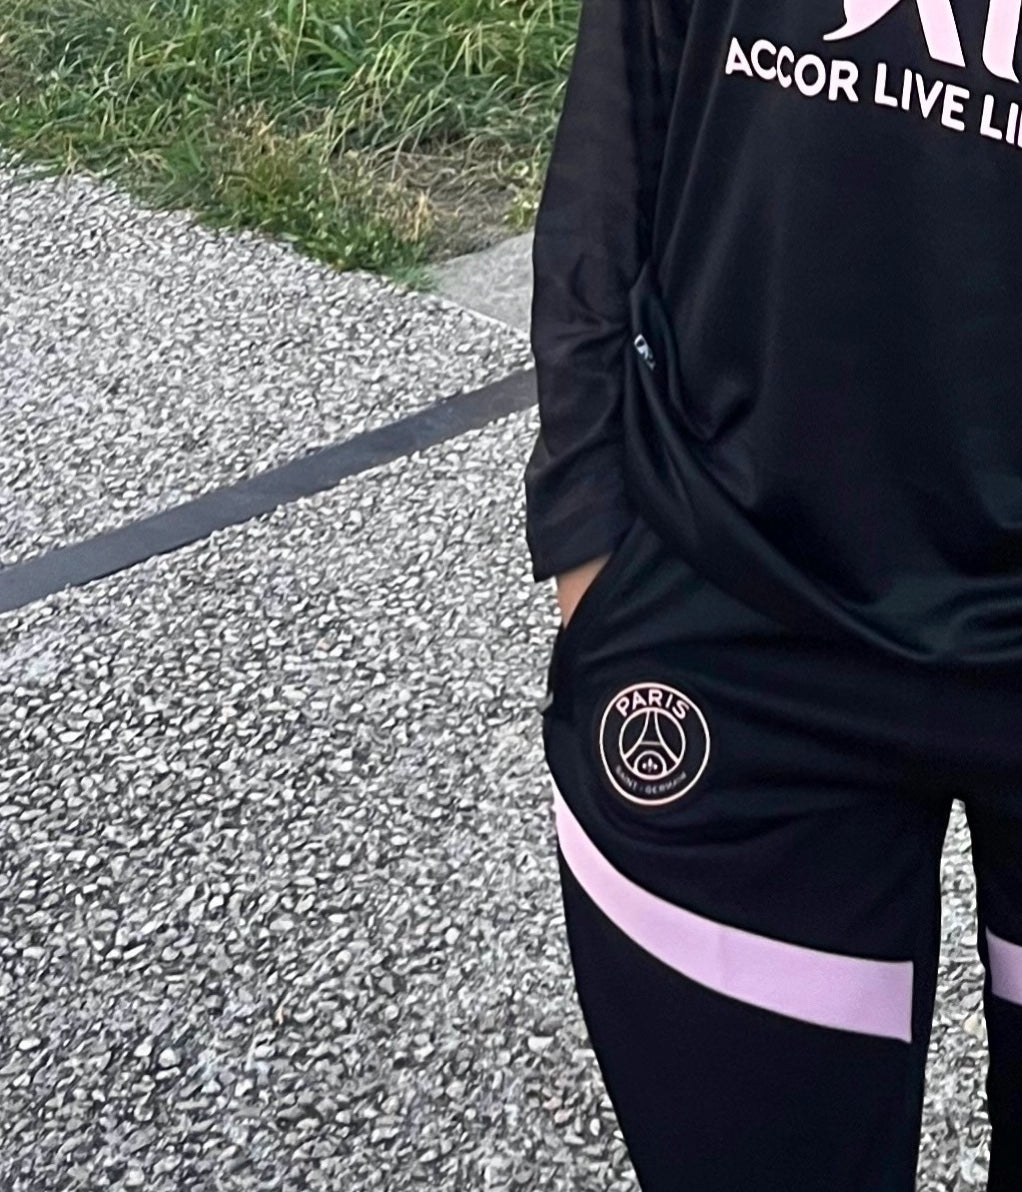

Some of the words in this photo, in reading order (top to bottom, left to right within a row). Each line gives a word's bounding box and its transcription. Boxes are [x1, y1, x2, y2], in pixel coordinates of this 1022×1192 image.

[724, 37, 859, 103] ACCOR
[873, 62, 970, 132] LIVE
[615, 688, 690, 720] PARIS
